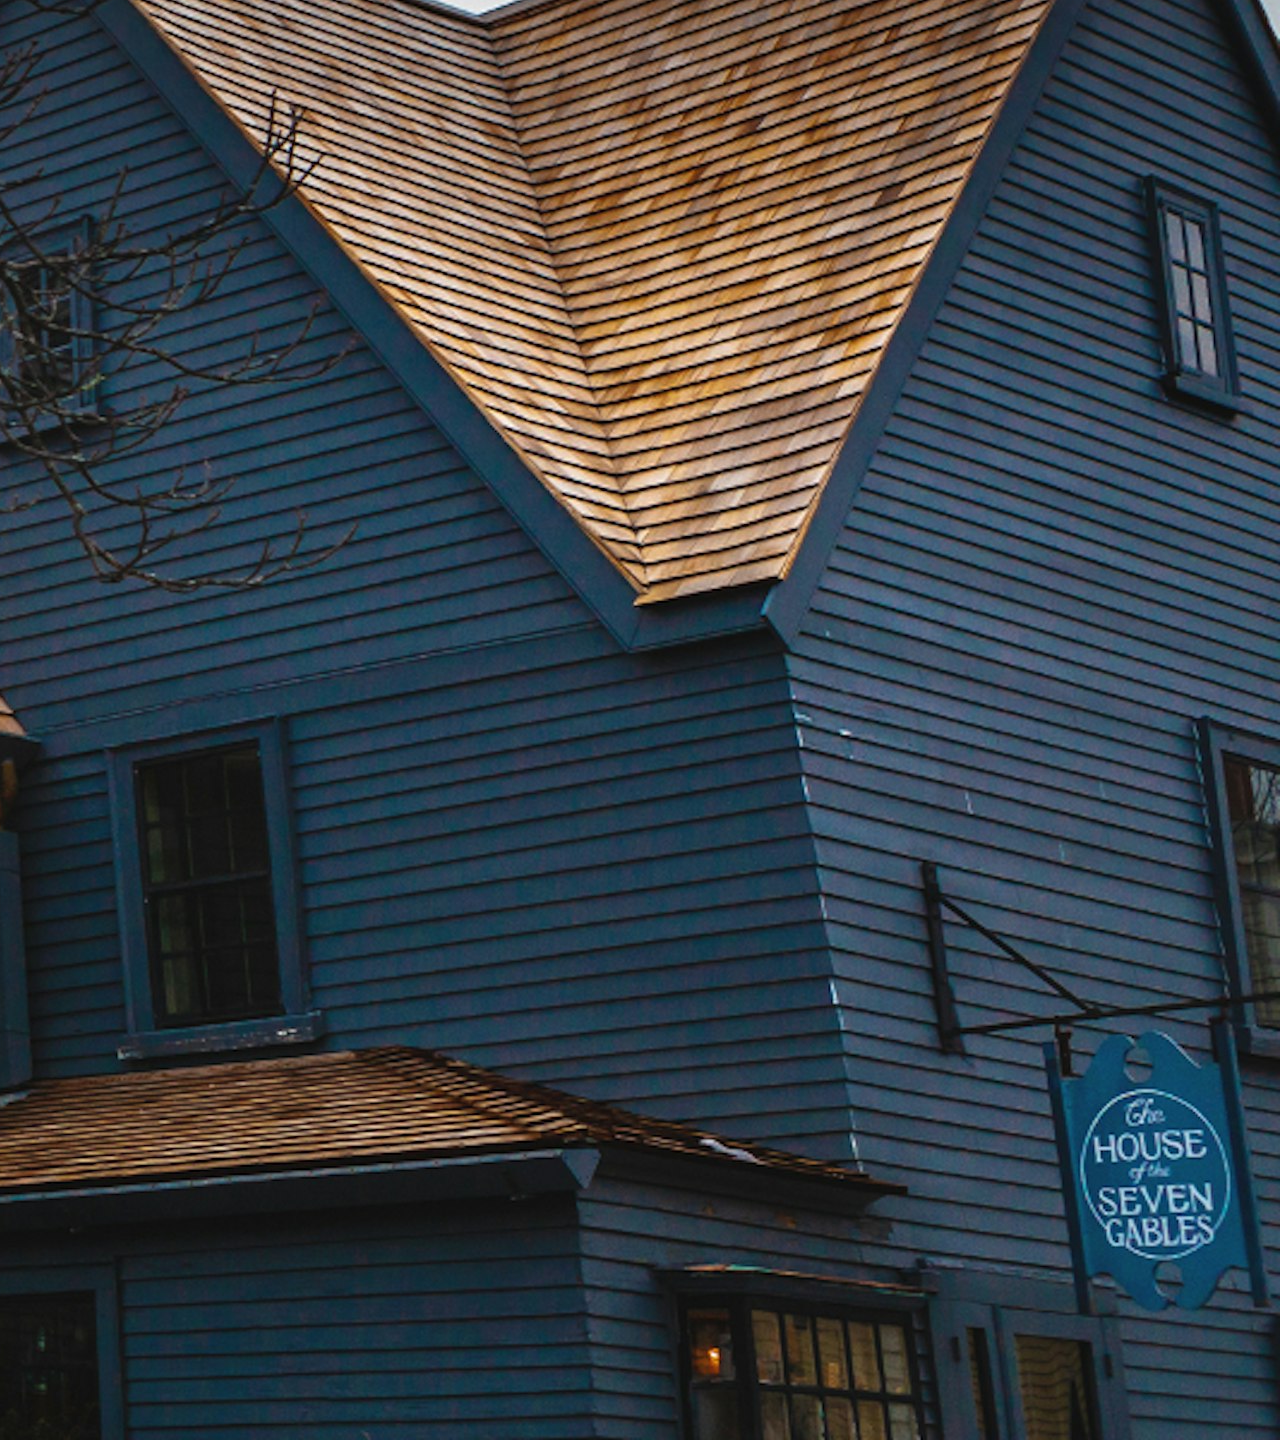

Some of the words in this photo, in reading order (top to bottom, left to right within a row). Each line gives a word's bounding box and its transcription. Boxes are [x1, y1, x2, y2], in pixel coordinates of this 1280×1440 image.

[1125, 1098, 1166, 1127] The
[1093, 1129, 1207, 1163] HOUSE
[1129, 1162, 1149, 1184] of
[1148, 1162, 1170, 1177] the
[1099, 1183, 1214, 1216] SEVEN
[1106, 1215, 1215, 1248] GABLES
